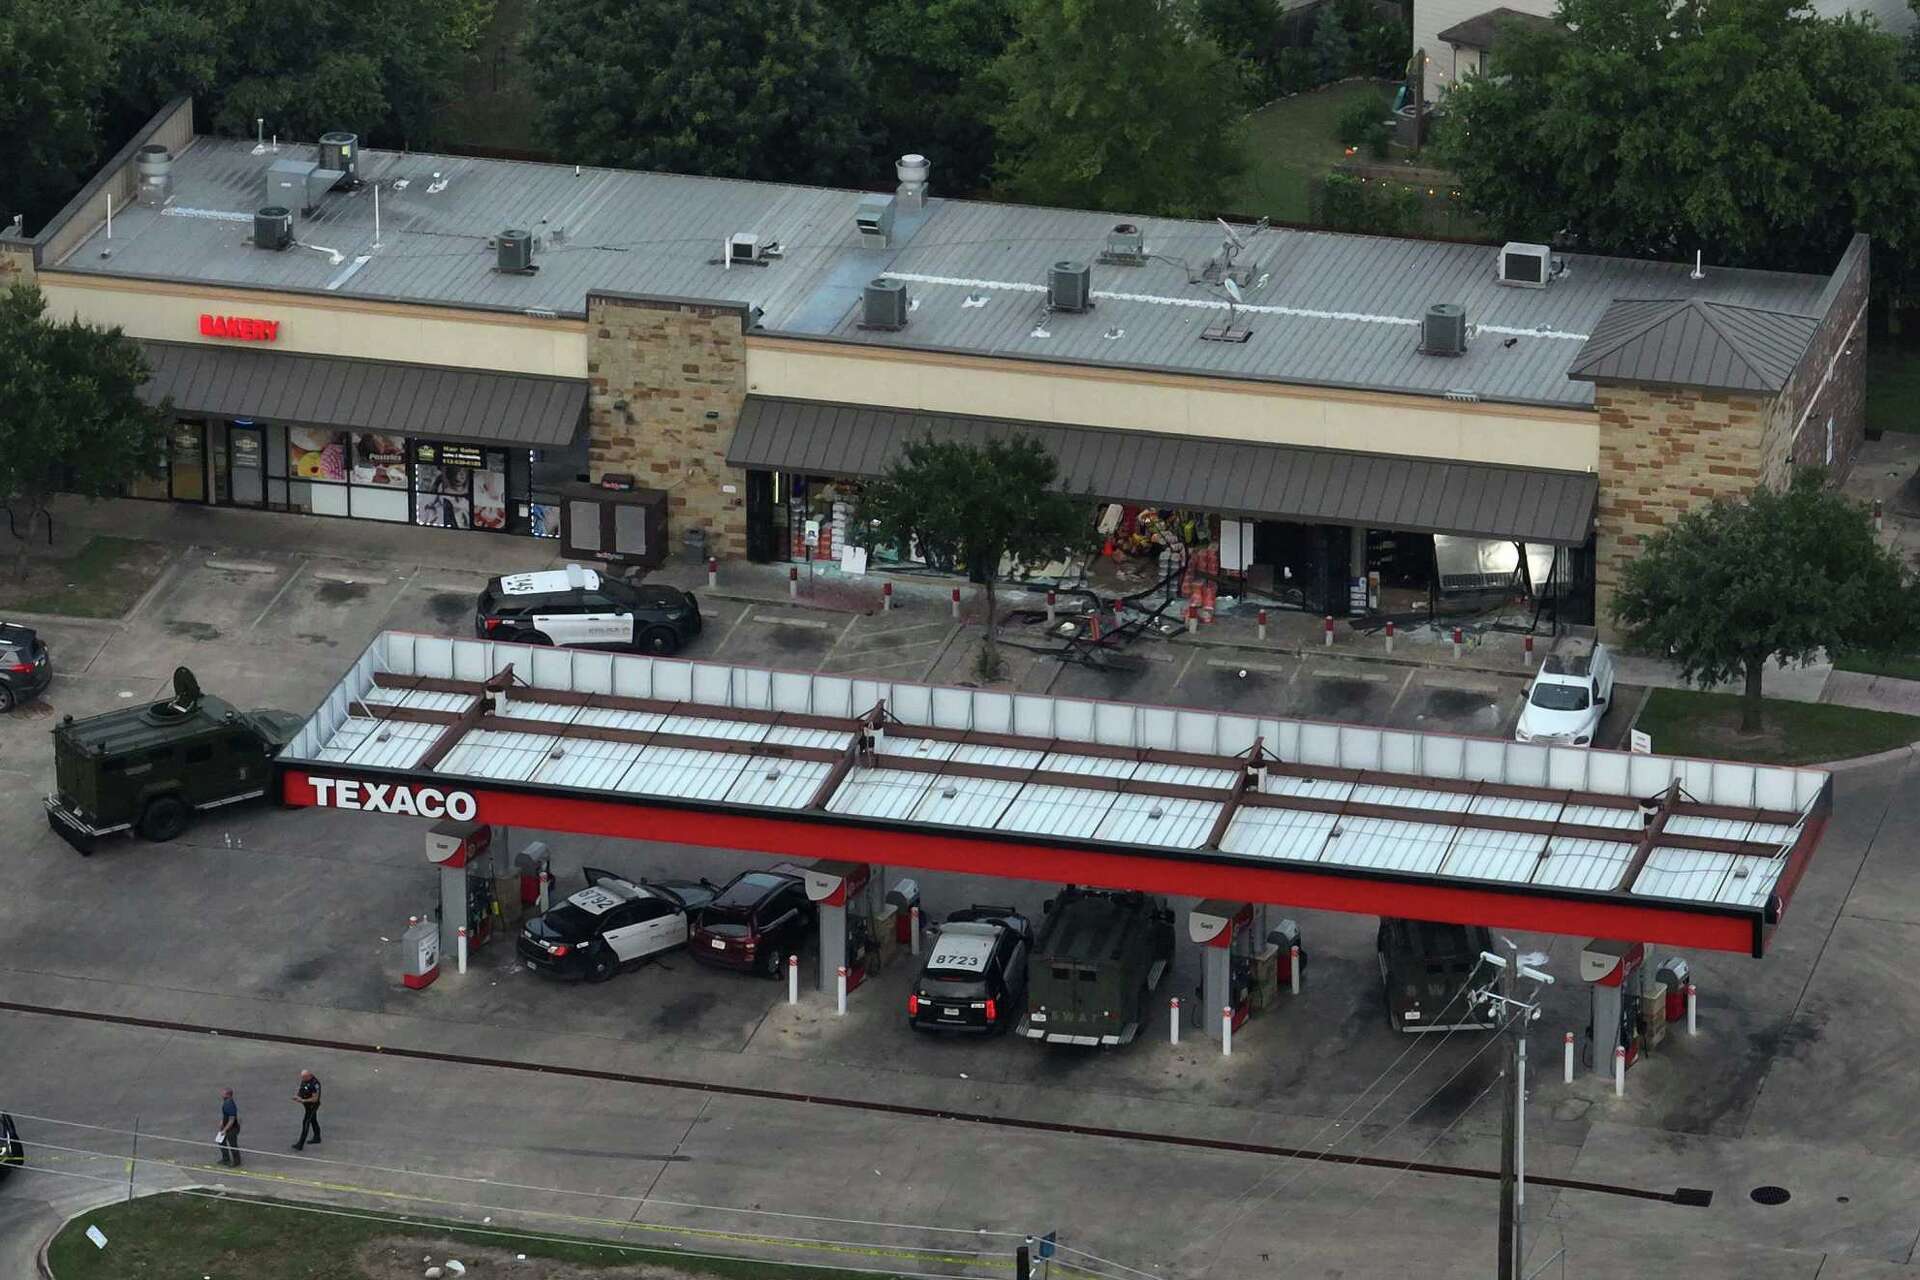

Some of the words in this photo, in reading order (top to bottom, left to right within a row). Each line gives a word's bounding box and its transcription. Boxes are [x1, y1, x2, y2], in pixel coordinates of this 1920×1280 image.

[200, 313, 279, 342] BAKERY
[308, 776, 477, 821] TEXACO
[936, 955, 978, 966] 8723
